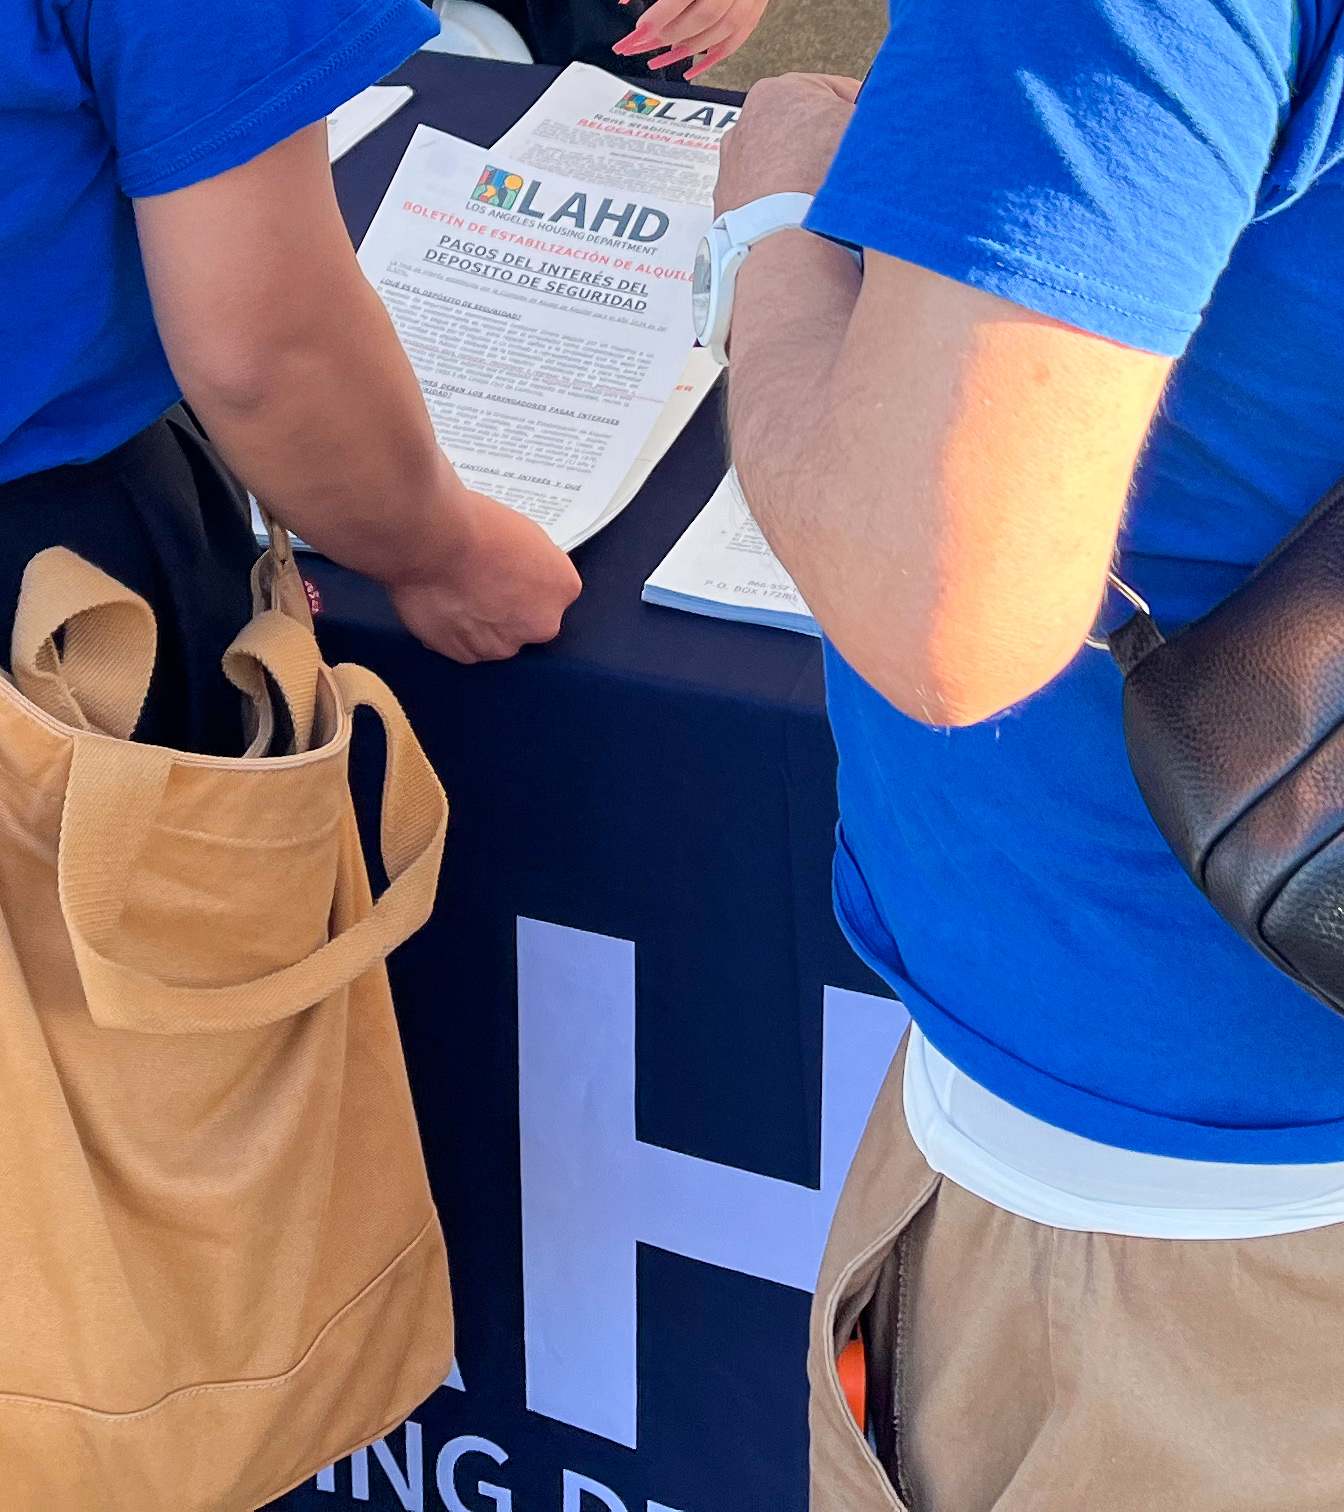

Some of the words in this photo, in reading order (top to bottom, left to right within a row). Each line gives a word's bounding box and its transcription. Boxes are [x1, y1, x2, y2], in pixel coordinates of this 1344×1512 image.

[577, 119, 671, 142] RELOCATION
[402, 200, 465, 228] BOLETÍN
[467, 222, 489, 235] DE
[491, 229, 610, 265] ESTABILIZACIÓN
[613, 258, 633, 270] DE
[635, 264, 694, 283] ALQUILE
[465, 201, 486, 215] LOS
[488, 209, 536, 228] ANGELES
[537, 222, 586, 240] HOUSING
[586, 233, 658, 256] DEPARTMENT
[517, 180, 670, 243] LAHD
[425, 249, 513, 280] DEPOSITO
[517, 274, 542, 288] DE
[544, 280, 647, 312] SEGURIDAD
[439, 235, 499, 260] PAGOS
[502, 253, 533, 270] DEL
[538, 261, 615, 287] INTERÉS
[617, 279, 649, 295] DEL
[734, 586, 757, 595] BOX
